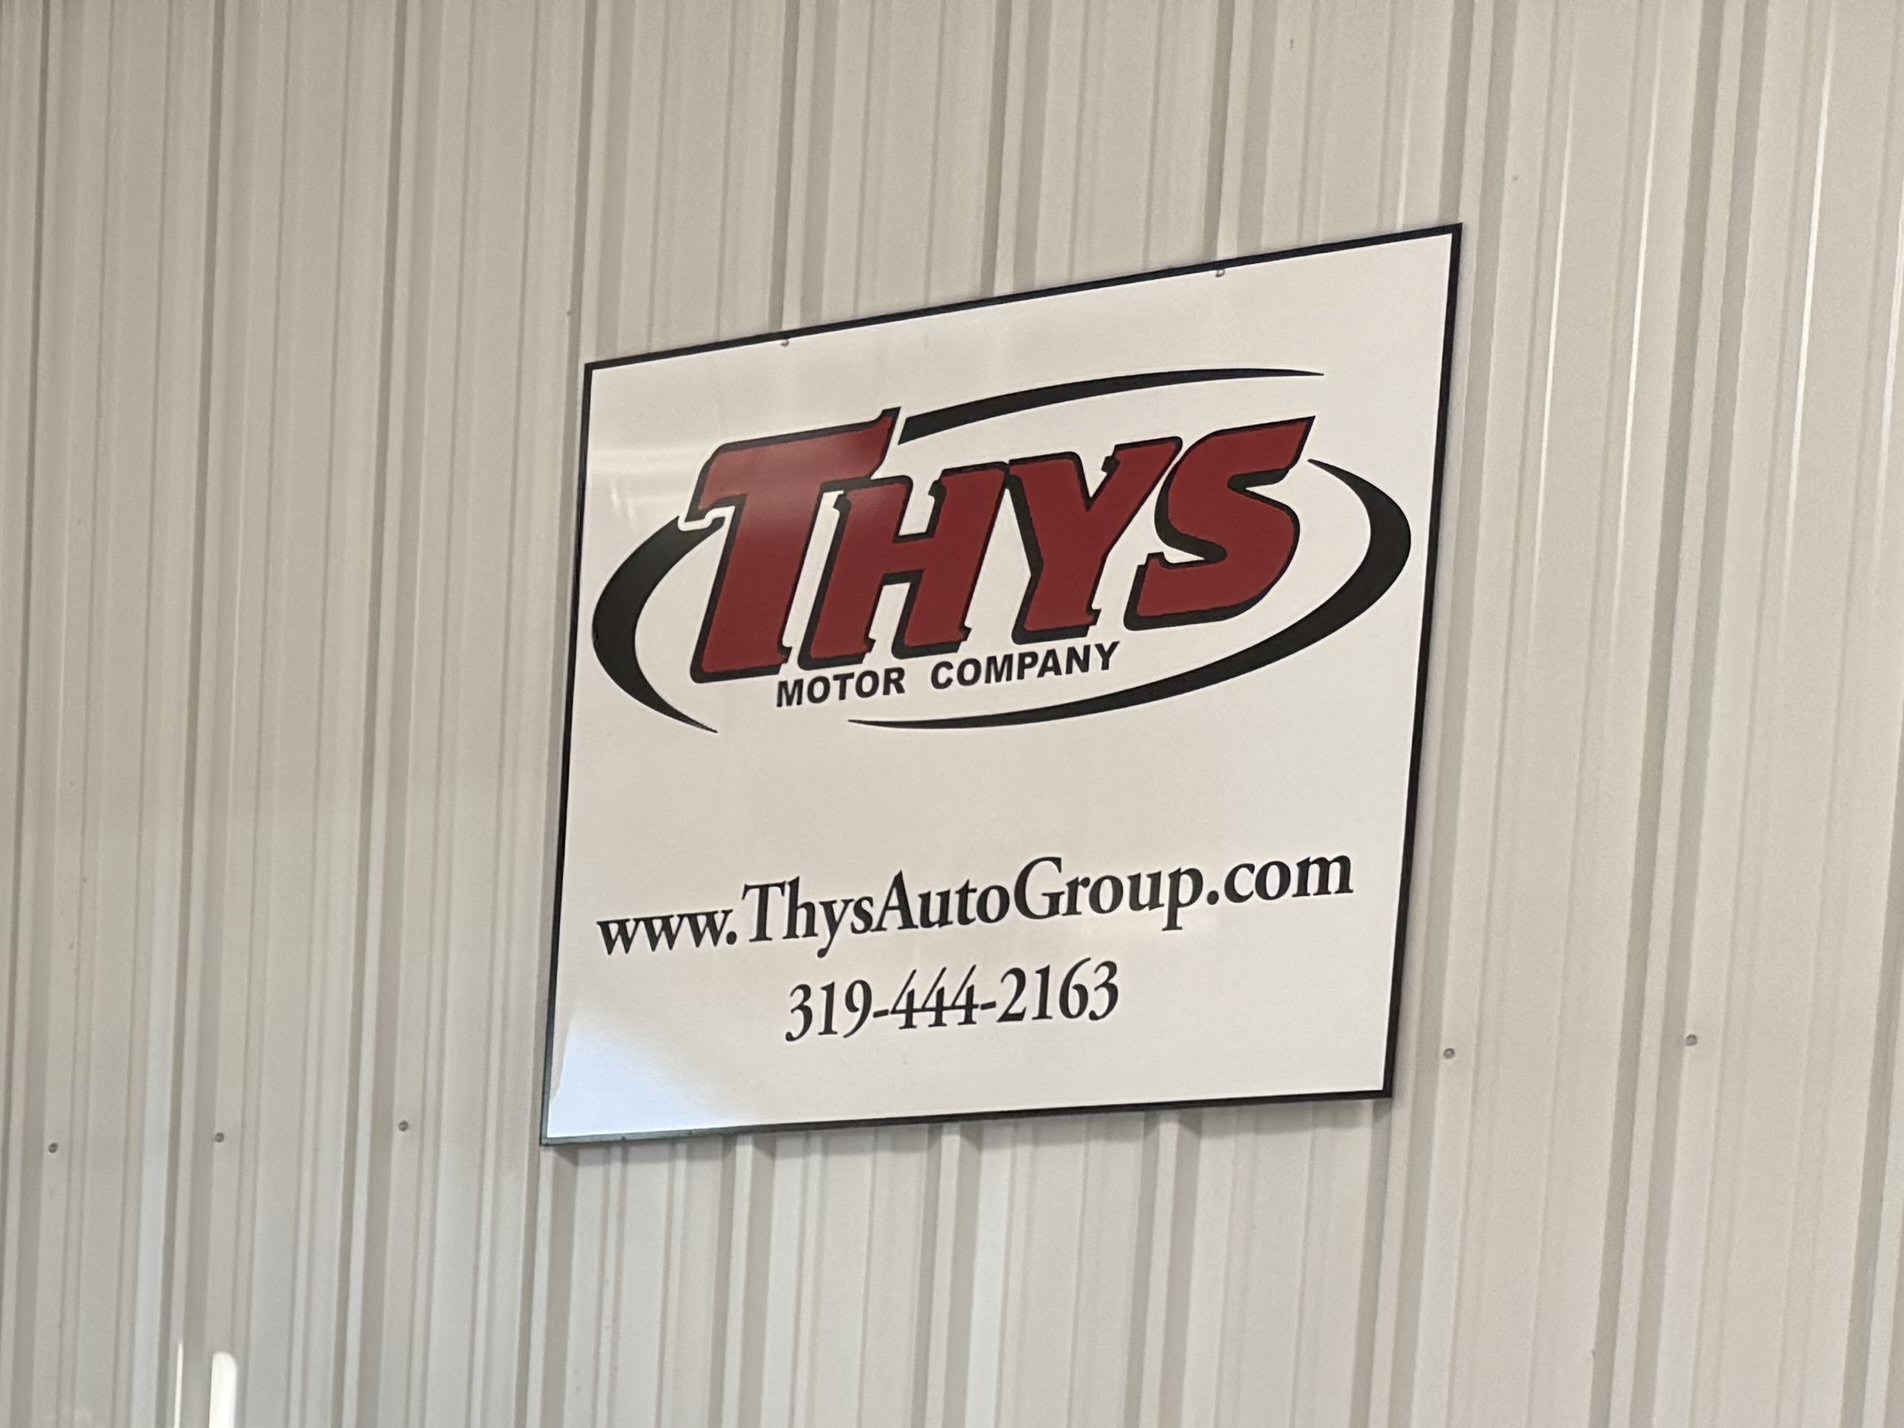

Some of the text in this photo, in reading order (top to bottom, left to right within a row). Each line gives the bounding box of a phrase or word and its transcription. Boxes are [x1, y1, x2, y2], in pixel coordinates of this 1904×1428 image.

[689, 406, 1316, 684] THYS
[775, 640, 1121, 709] MOTOR COMPANY
[597, 851, 1354, 959] www.ThysAutoGroup.com
[784, 958, 1120, 1043] 319-444-2163
